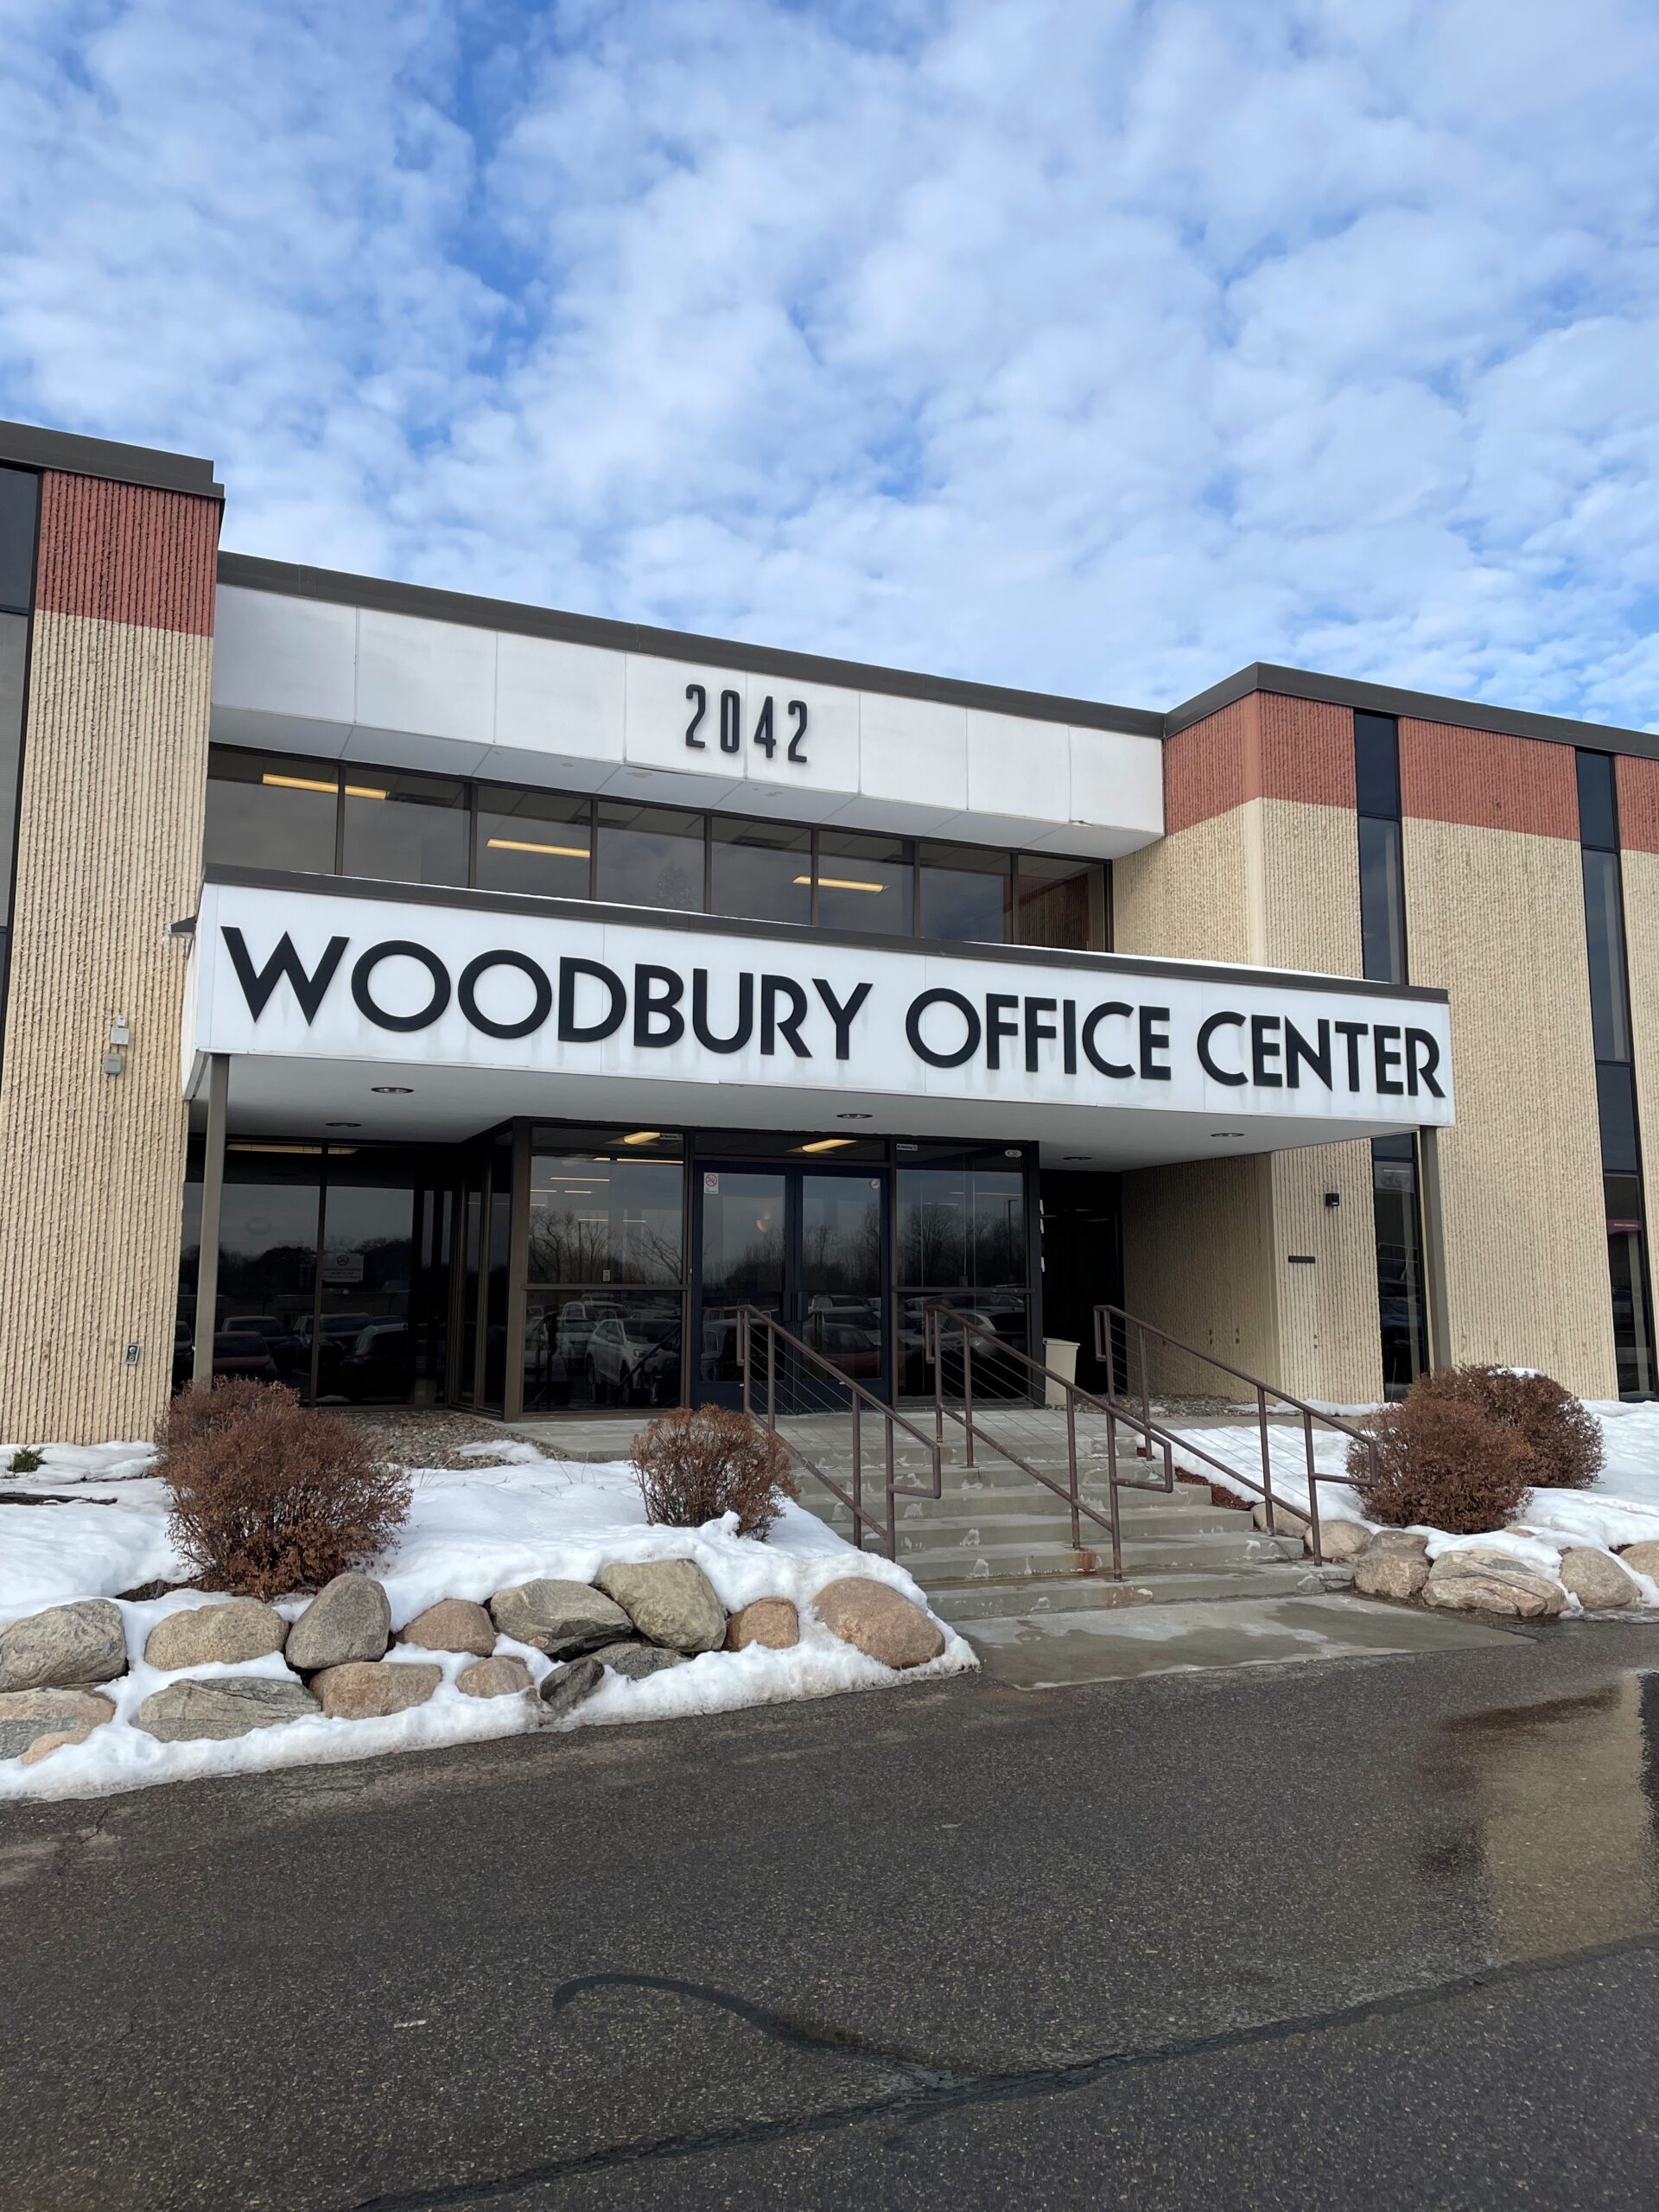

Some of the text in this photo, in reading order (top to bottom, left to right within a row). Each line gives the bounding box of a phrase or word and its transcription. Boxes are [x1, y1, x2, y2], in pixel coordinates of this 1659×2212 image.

[685, 683, 808, 763] 2042
[220, 925, 1446, 1098] WOODBURY OFFICE CENTER
